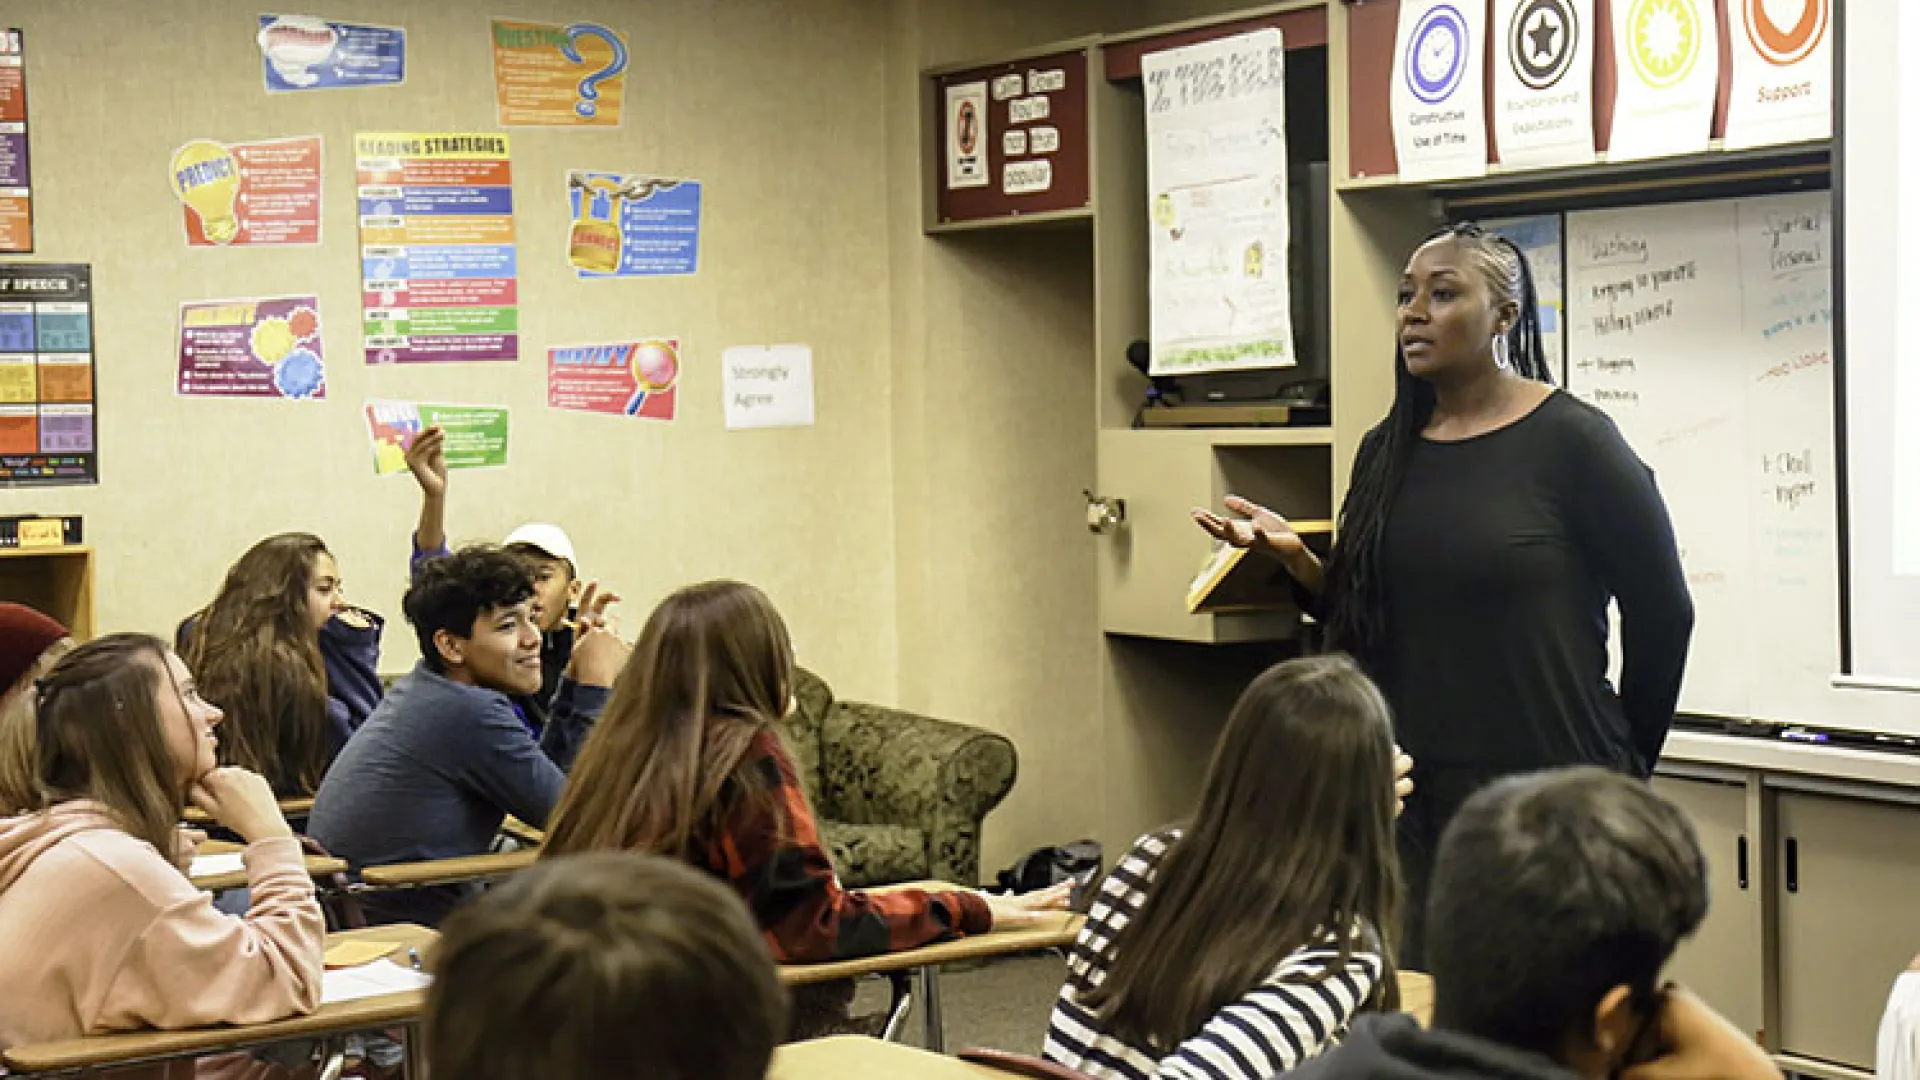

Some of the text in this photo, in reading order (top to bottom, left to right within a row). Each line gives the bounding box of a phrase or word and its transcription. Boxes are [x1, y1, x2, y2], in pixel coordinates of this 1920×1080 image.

[1561, 91, 1580, 105] and
[1756, 81, 1812, 103] Support
[1407, 110, 1466, 126] Constructive
[359, 136, 506, 155] READING STRATEGIES
[1413, 132, 1467, 148] Use of Time
[176, 156, 236, 193] PREDICT
[14, 277, 68, 290] SPEECH
[731, 365, 790, 381] Strongly
[734, 393, 773, 410] Agree
